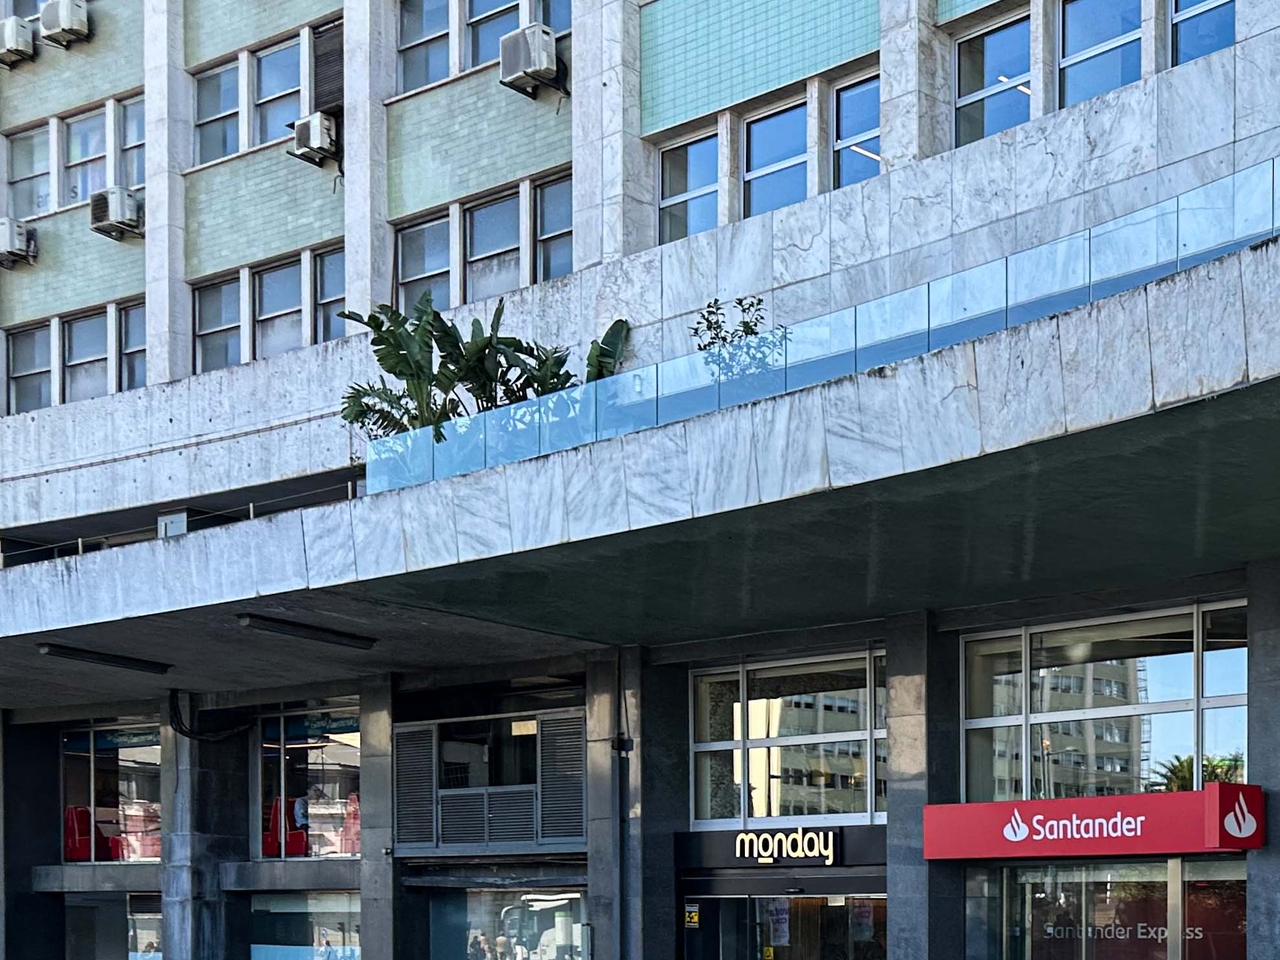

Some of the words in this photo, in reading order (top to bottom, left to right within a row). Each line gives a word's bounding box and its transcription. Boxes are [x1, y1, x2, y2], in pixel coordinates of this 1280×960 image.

[1032, 811, 1145, 840] Santander
[736, 827, 833, 865] monday
[1043, 922, 1133, 939] Santnder
[1137, 923, 1203, 943] Expss
